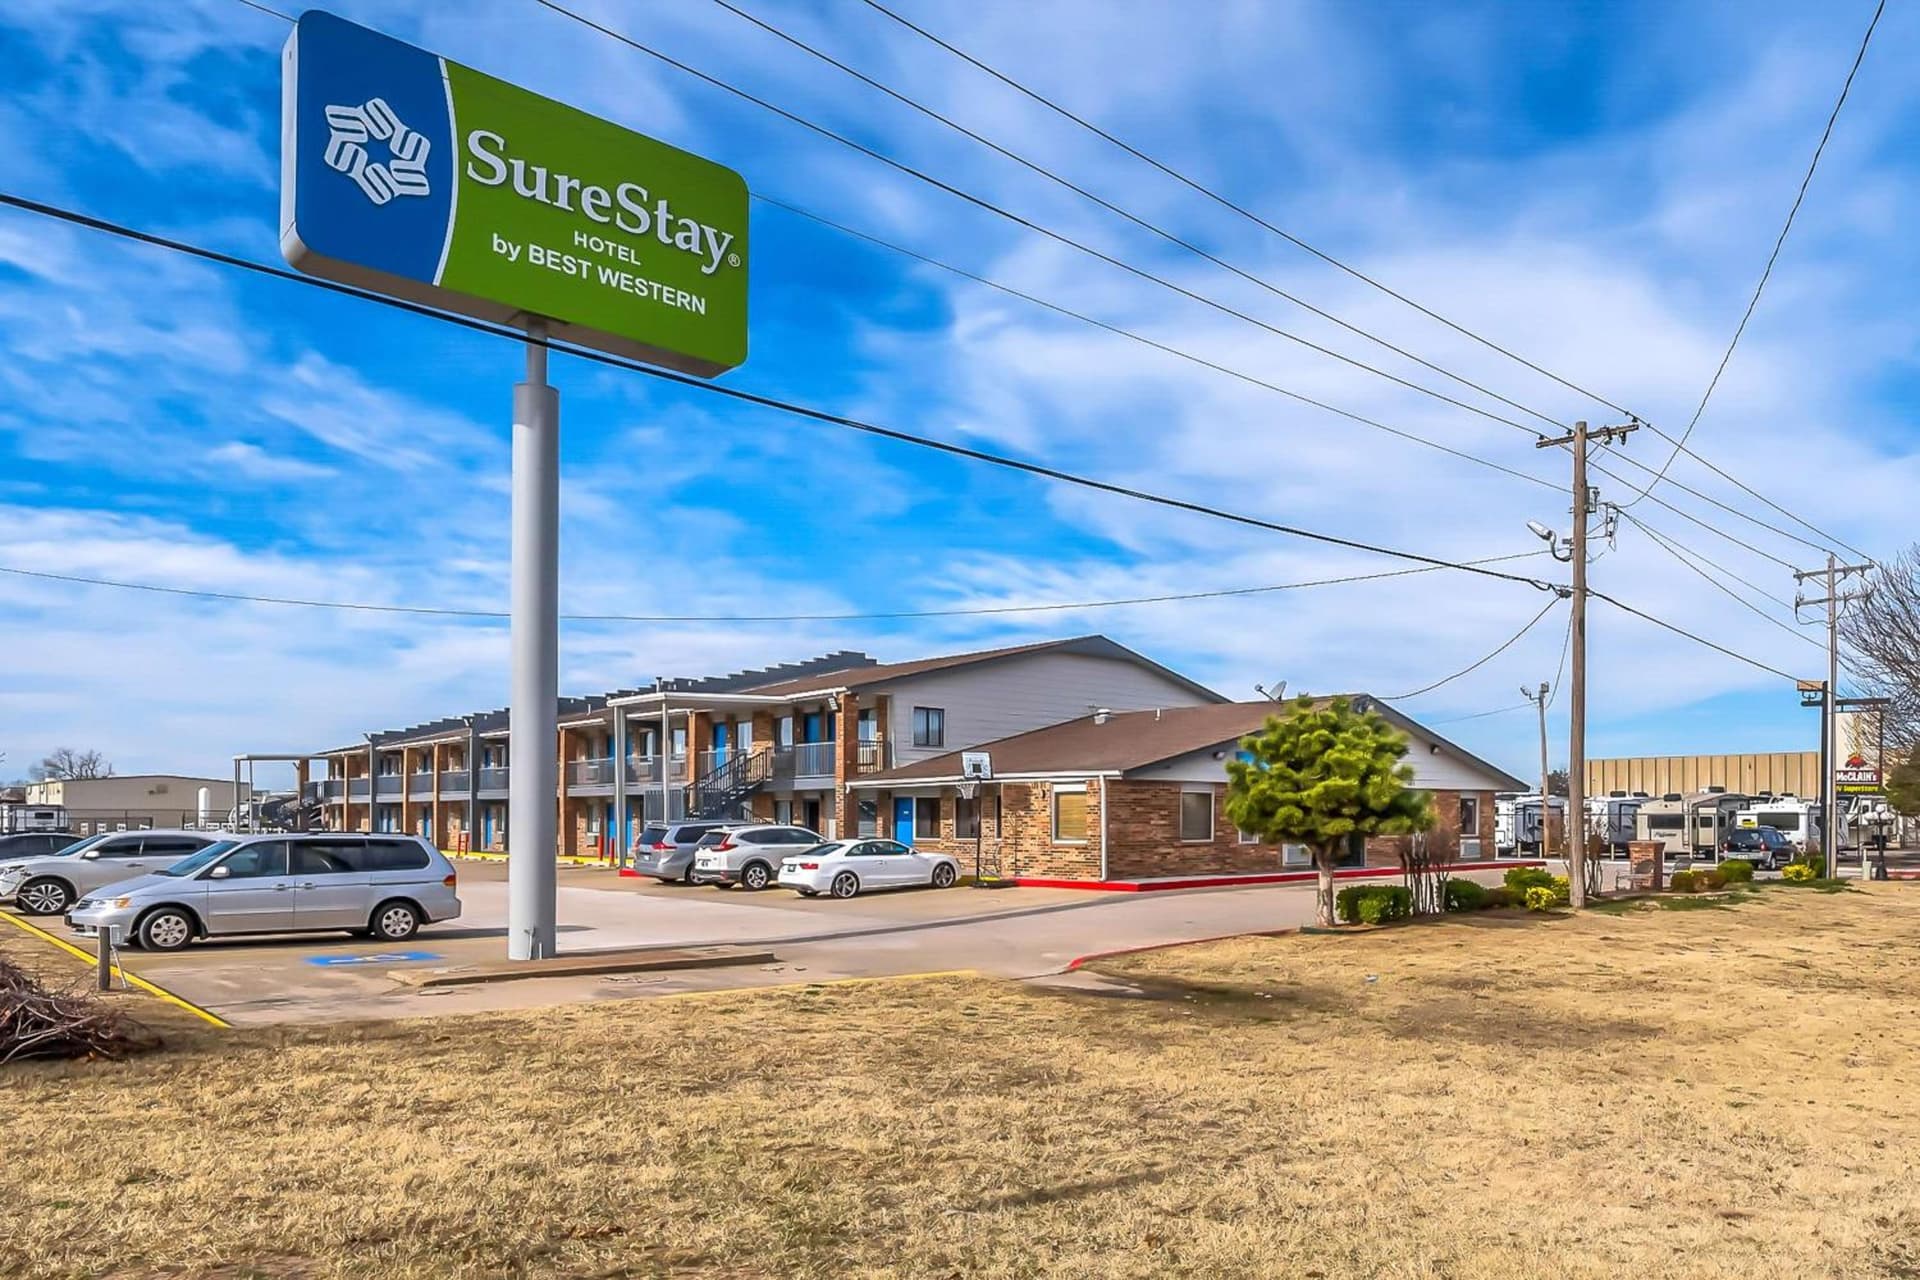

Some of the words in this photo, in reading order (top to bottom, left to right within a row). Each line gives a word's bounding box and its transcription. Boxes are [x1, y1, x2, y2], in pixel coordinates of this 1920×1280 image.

[492, 232, 522, 262] by
[528, 243, 592, 279] BEST
[597, 265, 706, 315] WESTERN
[574, 230, 641, 266] HOTEL
